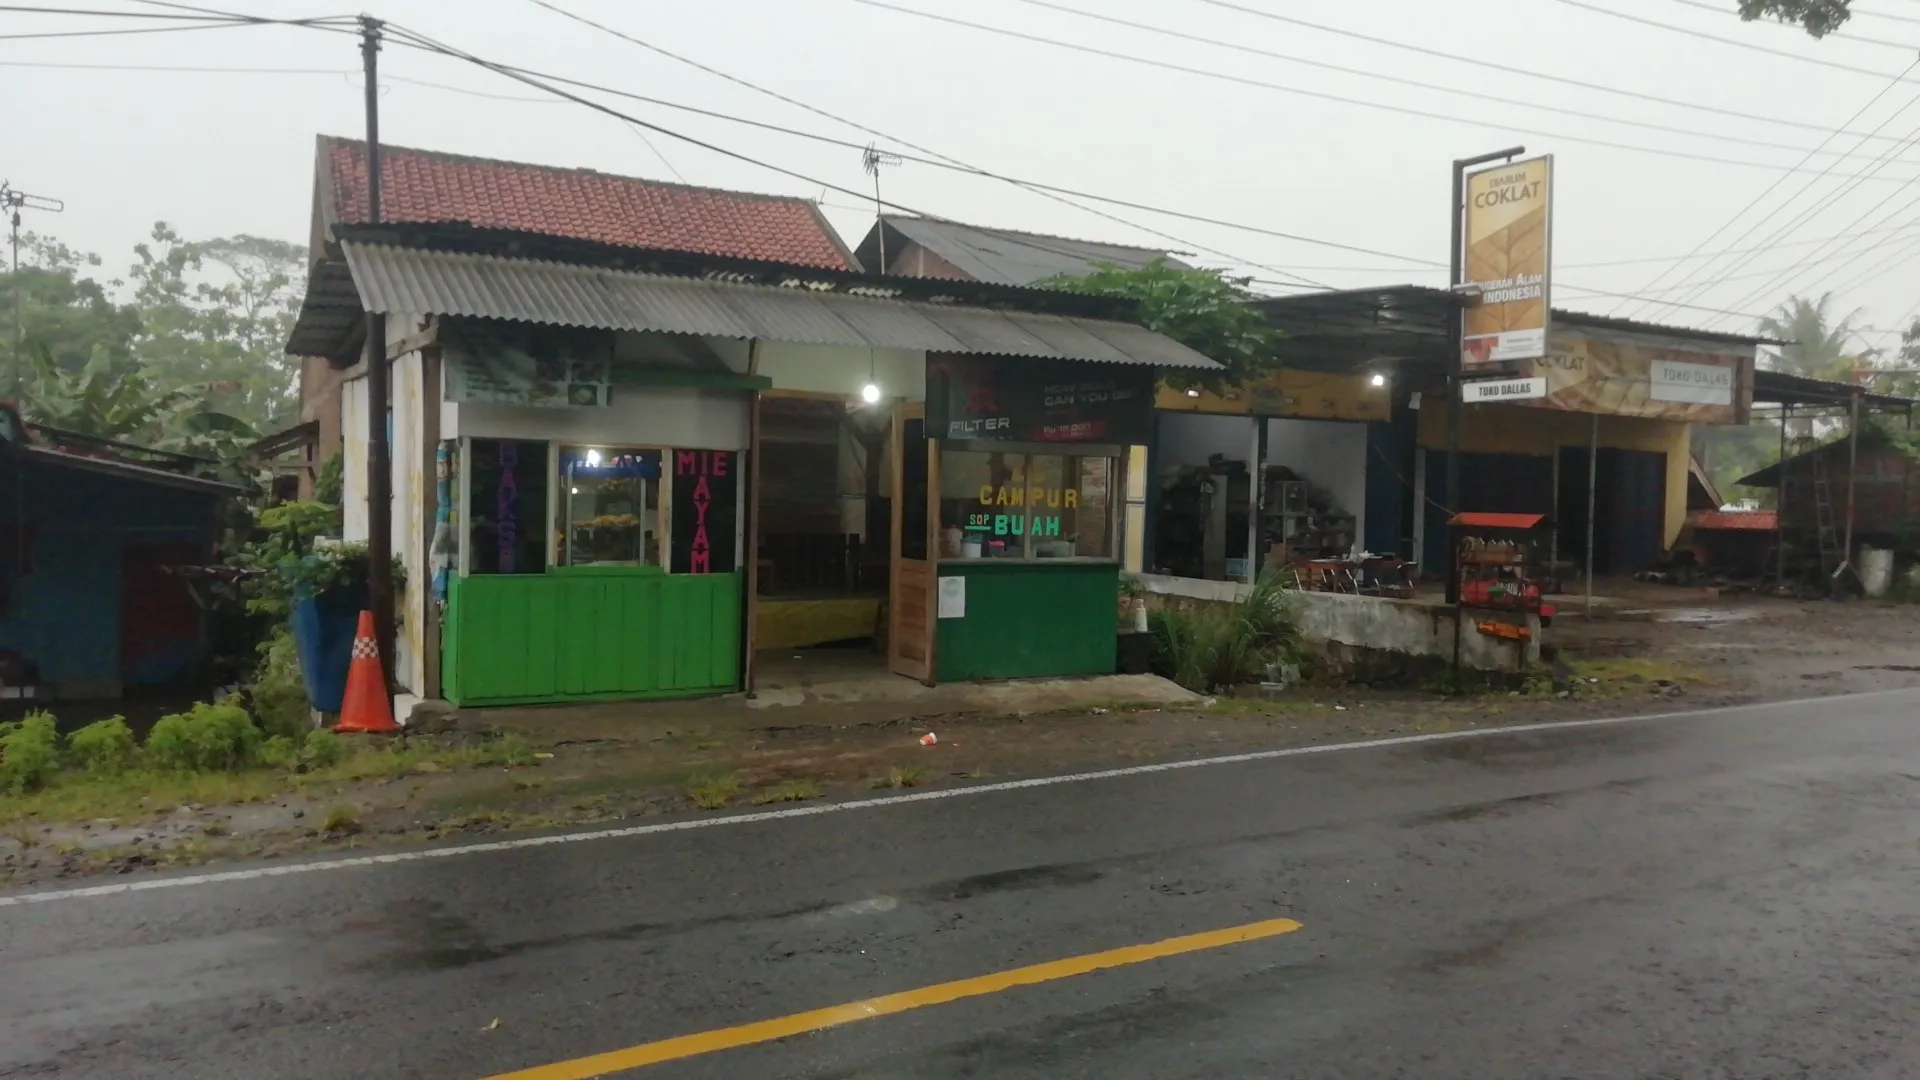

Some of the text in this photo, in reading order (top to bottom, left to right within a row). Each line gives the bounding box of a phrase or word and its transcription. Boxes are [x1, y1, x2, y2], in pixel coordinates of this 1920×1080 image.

[1474, 180, 1541, 209] COKLAT
[1515, 272, 1543, 286] ALAM
[1482, 285, 1542, 305] INDONESIA
[1663, 368, 1690, 382] TOKO
[1478, 382, 1531, 396] TOKO DALLAS
[1044, 394, 1075, 407] CAN
[949, 416, 1011, 433] FILTER
[676, 451, 727, 476] MIE
[979, 484, 1078, 509] CAMPUR
[691, 475, 711, 574] AYAM
[969, 513, 1060, 536] SOP BUAH
